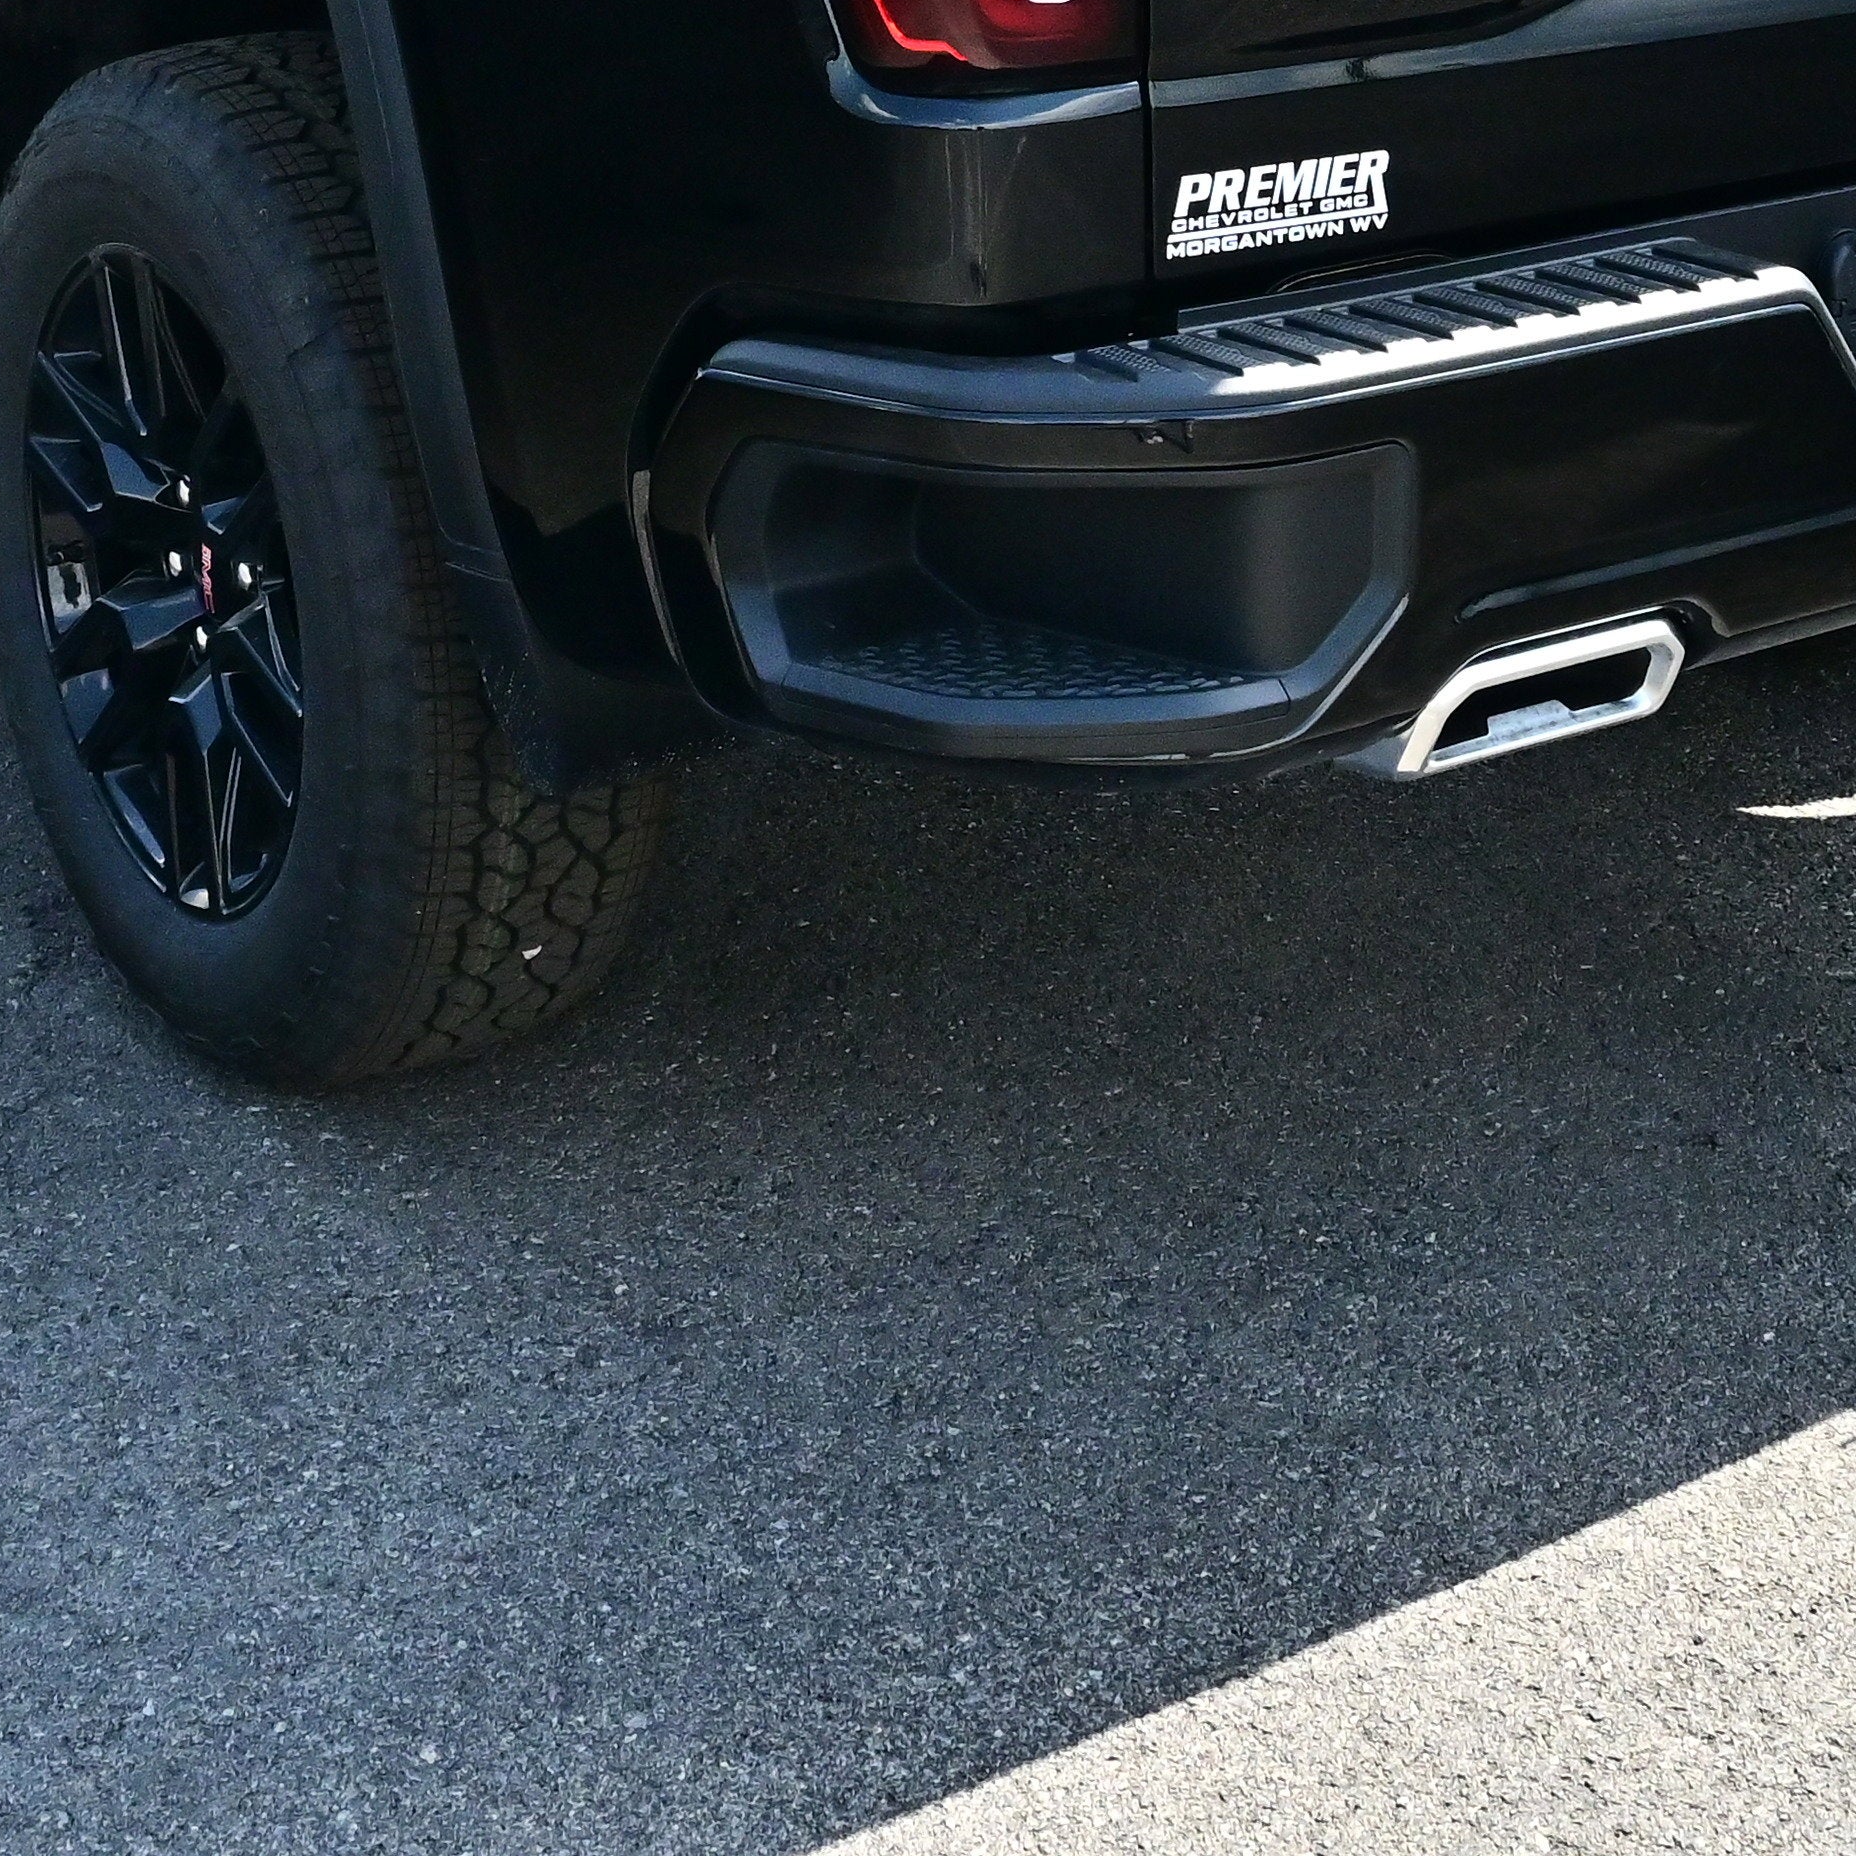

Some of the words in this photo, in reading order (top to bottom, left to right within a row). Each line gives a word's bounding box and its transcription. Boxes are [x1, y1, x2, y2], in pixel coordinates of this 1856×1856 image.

[1173, 149, 1390, 218] PREMIER
[1166, 219, 1344, 260] MORGANTOWN
[1349, 213, 1389, 233] WV
[1171, 200, 1314, 233] CHEVROLET
[1319, 193, 1369, 213] GMC
